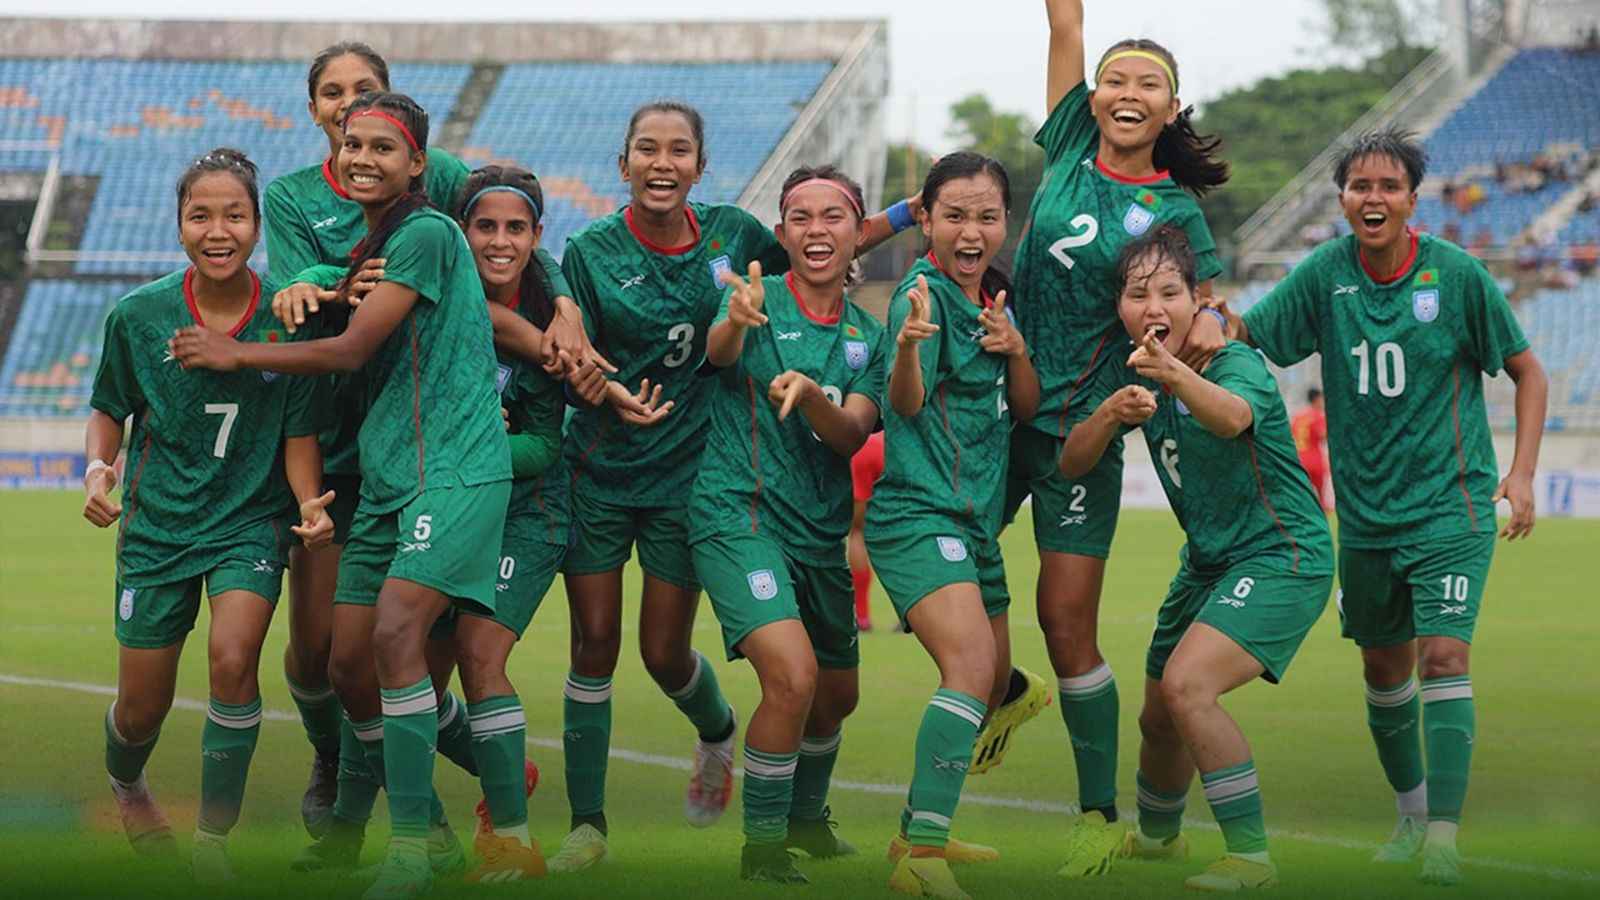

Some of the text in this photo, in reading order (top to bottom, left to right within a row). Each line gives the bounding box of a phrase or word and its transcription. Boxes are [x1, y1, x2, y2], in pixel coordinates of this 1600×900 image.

[1048, 213, 1098, 269] 2
[663, 323, 695, 367] 3
[1351, 339, 1406, 398] 10
[205, 403, 239, 458] 7
[1070, 484, 1087, 511] 2
[414, 514, 432, 541] 5
[499, 556, 515, 580] 0
[1233, 576, 1255, 599] 6
[1441, 574, 1468, 601] 10
